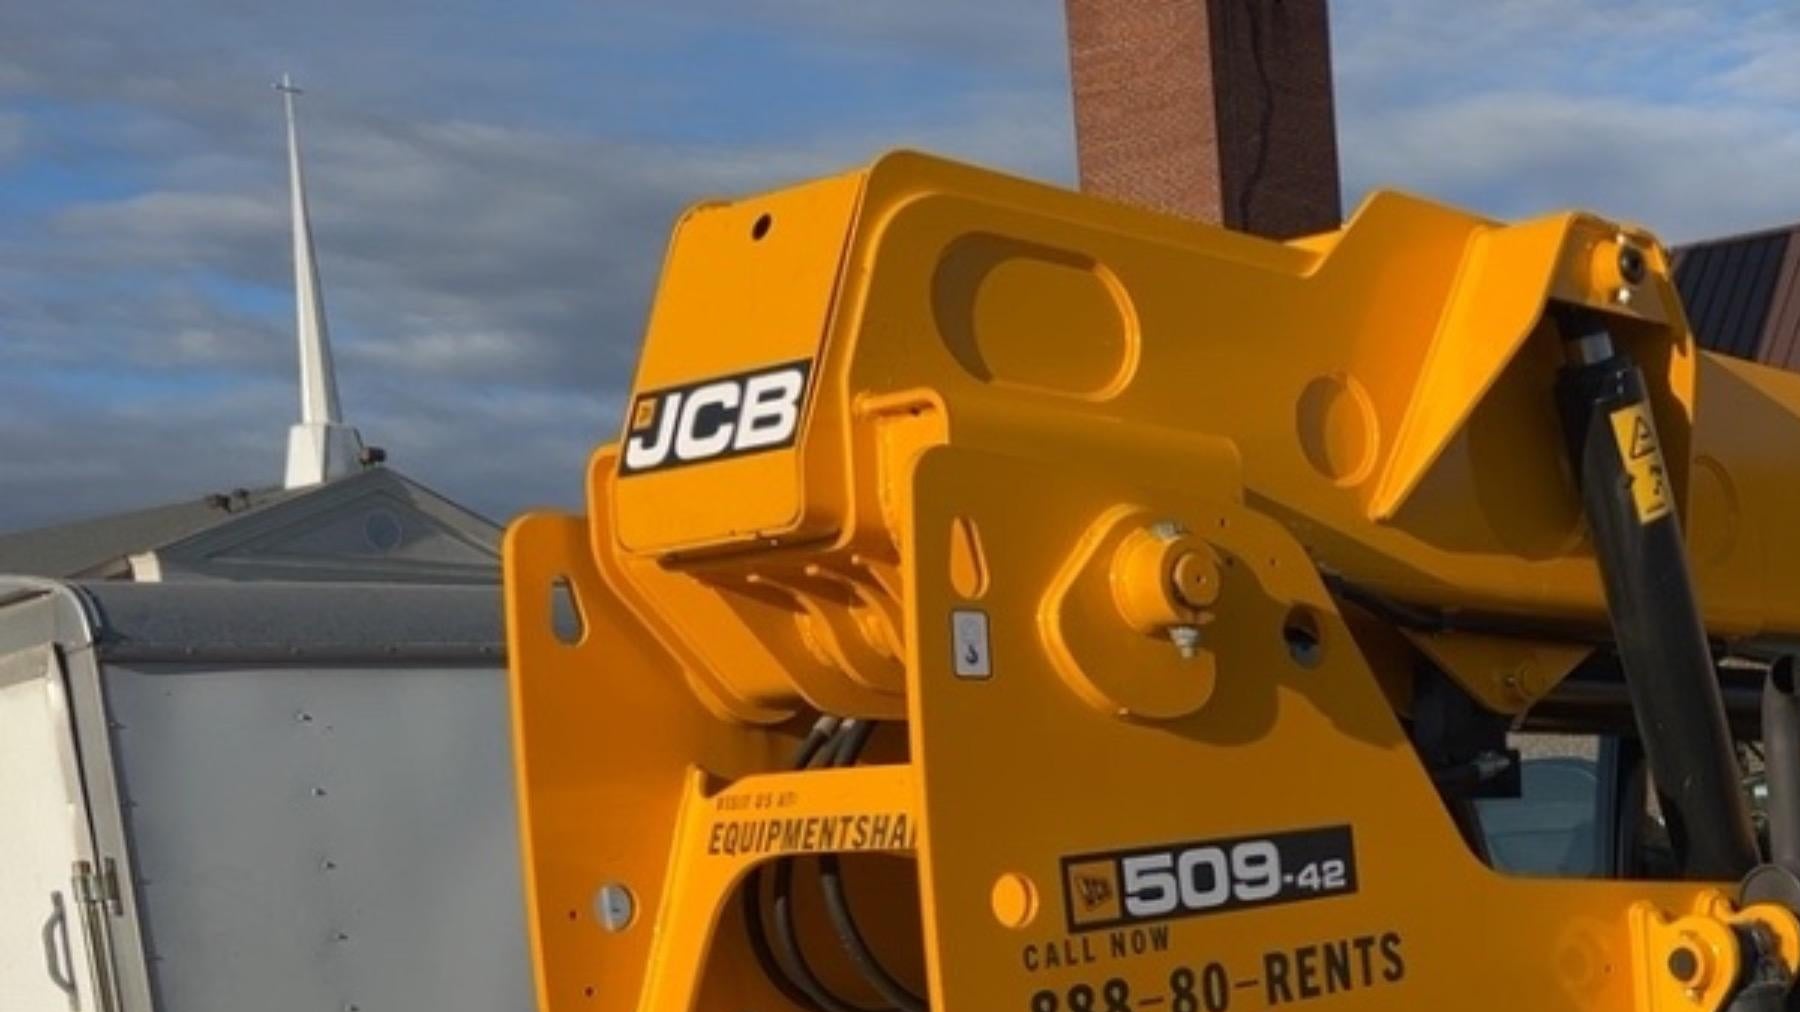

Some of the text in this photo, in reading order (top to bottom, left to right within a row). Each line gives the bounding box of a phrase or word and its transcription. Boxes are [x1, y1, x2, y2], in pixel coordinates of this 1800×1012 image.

[626, 368, 804, 470] JCB
[708, 812, 917, 857] EQUIPMENTSHA
[1023, 925, 1171, 971] CALL NOW
